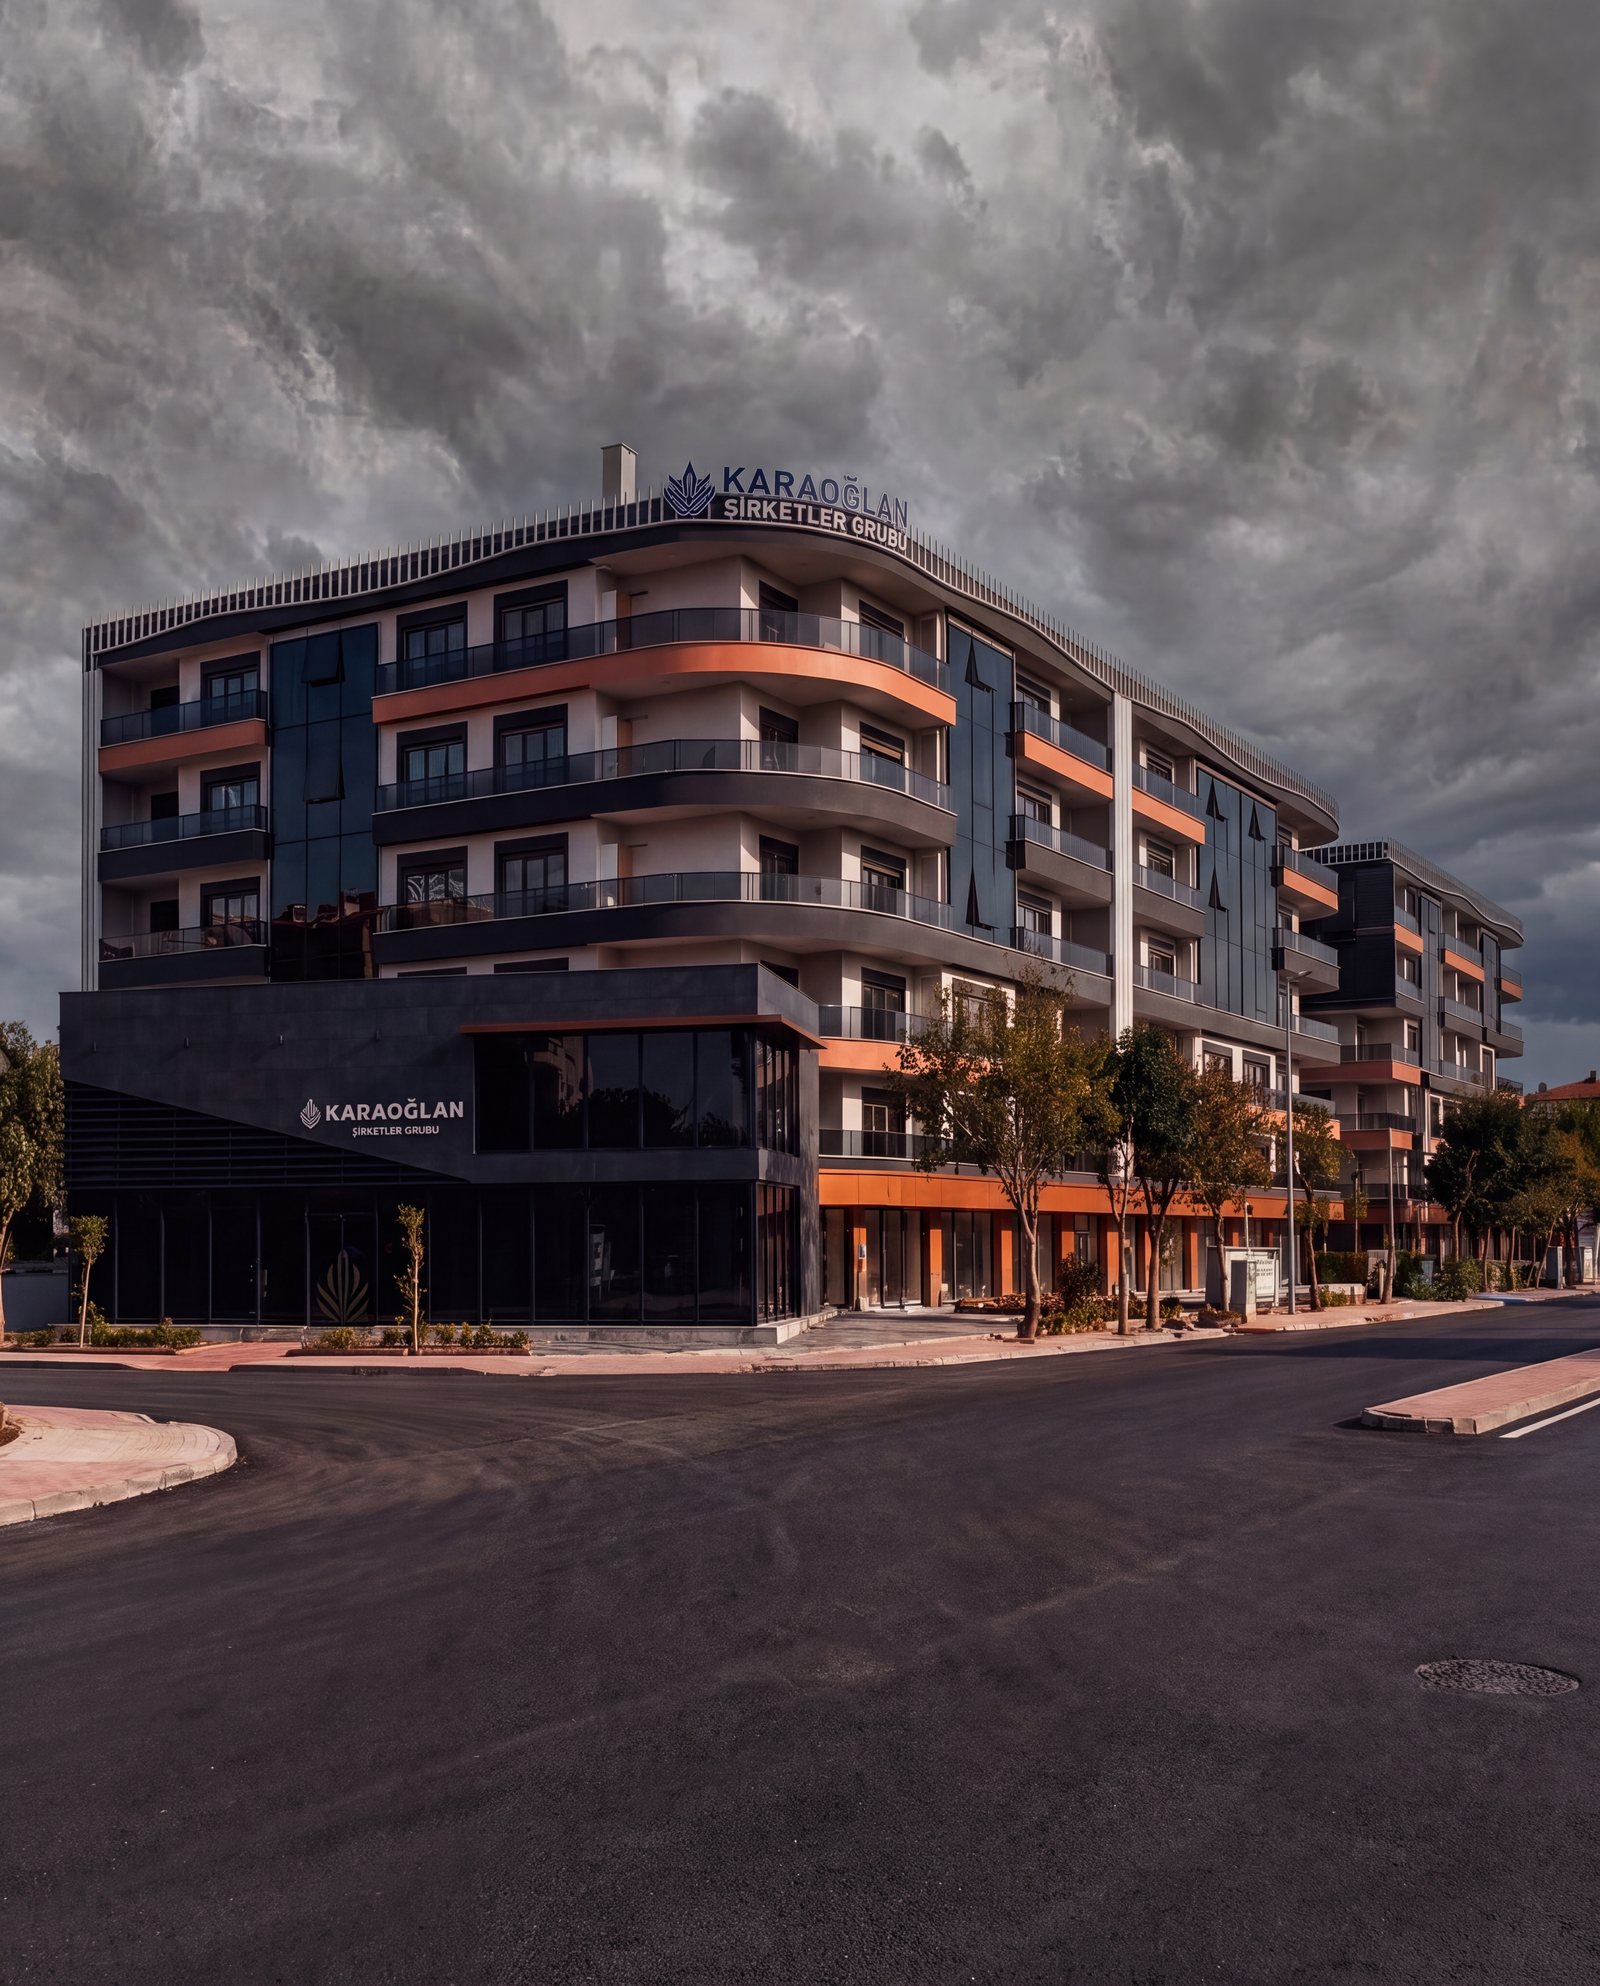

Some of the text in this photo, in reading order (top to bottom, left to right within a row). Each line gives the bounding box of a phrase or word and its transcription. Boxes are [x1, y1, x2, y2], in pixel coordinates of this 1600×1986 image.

[723, 466, 908, 529] KARAOĞLAN
[851, 515, 908, 551] GRUBU
[325, 1098, 464, 1121] KARAOĞLAN
[352, 1125, 440, 1138] ŞİRKETLER GRUBU
